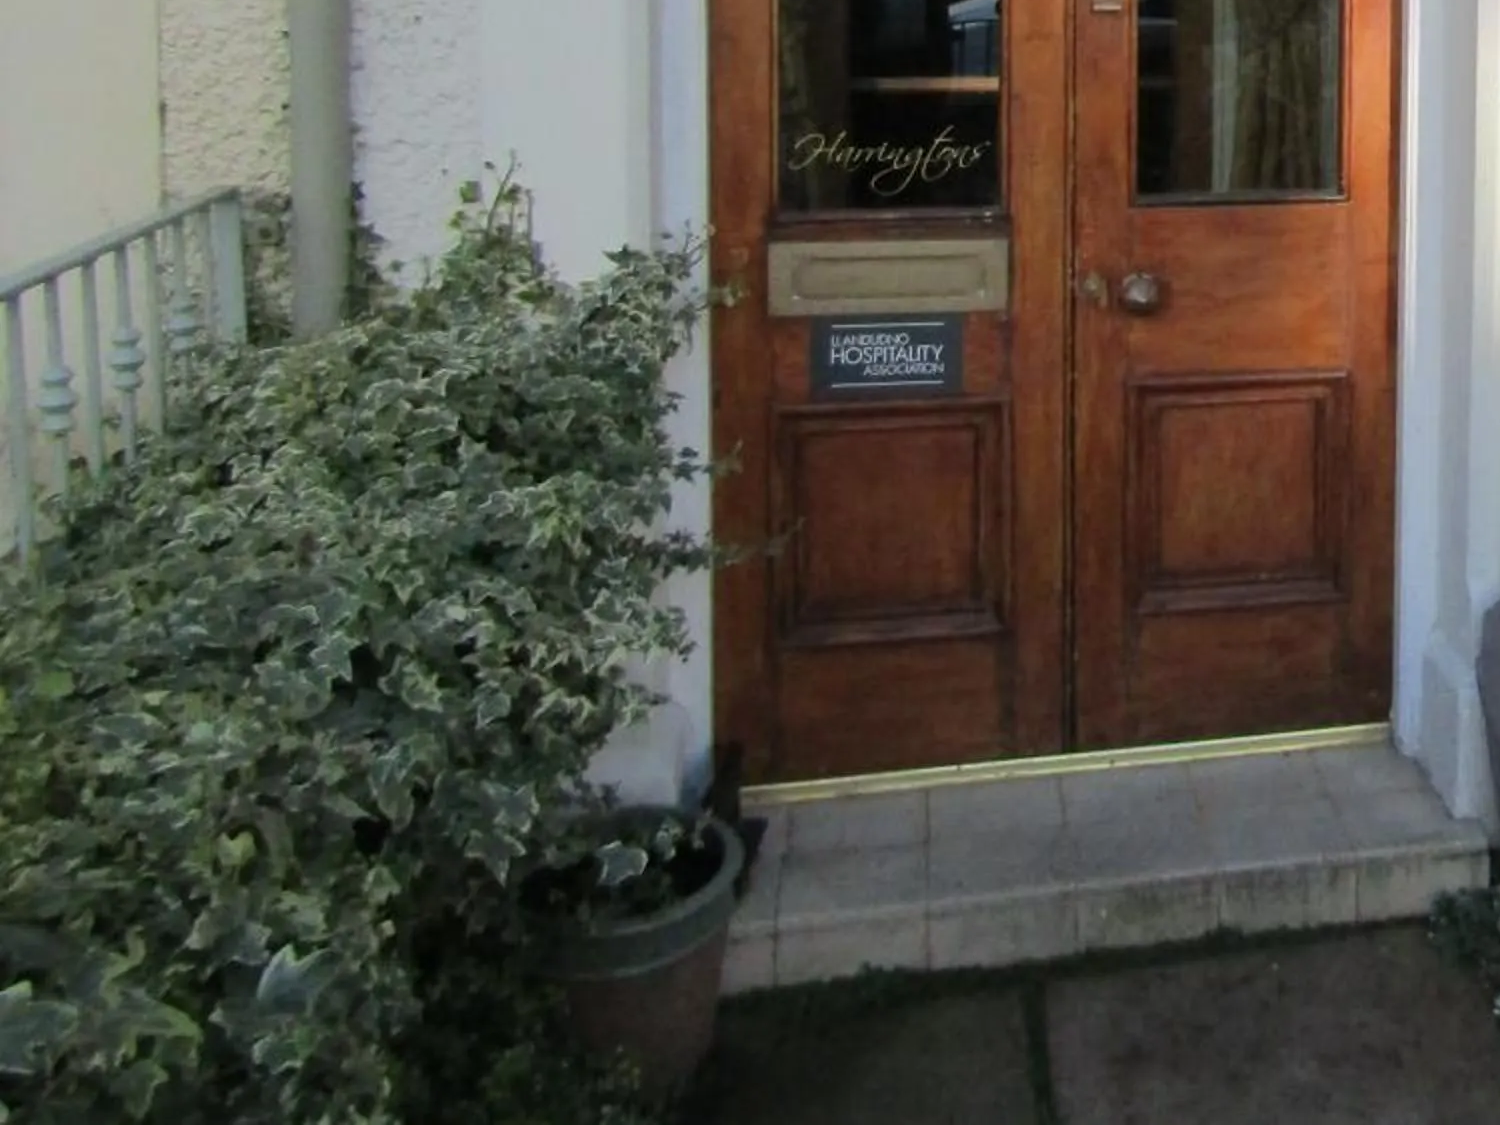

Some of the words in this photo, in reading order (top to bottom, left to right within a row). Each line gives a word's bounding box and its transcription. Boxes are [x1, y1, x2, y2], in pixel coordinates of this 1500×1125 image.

[788, 124, 992, 197] Harringtons
[831, 332, 910, 347] LLANDUDNO
[830, 343, 945, 365] HOSPITALITY
[862, 361, 945, 377] ASSOCIATION
